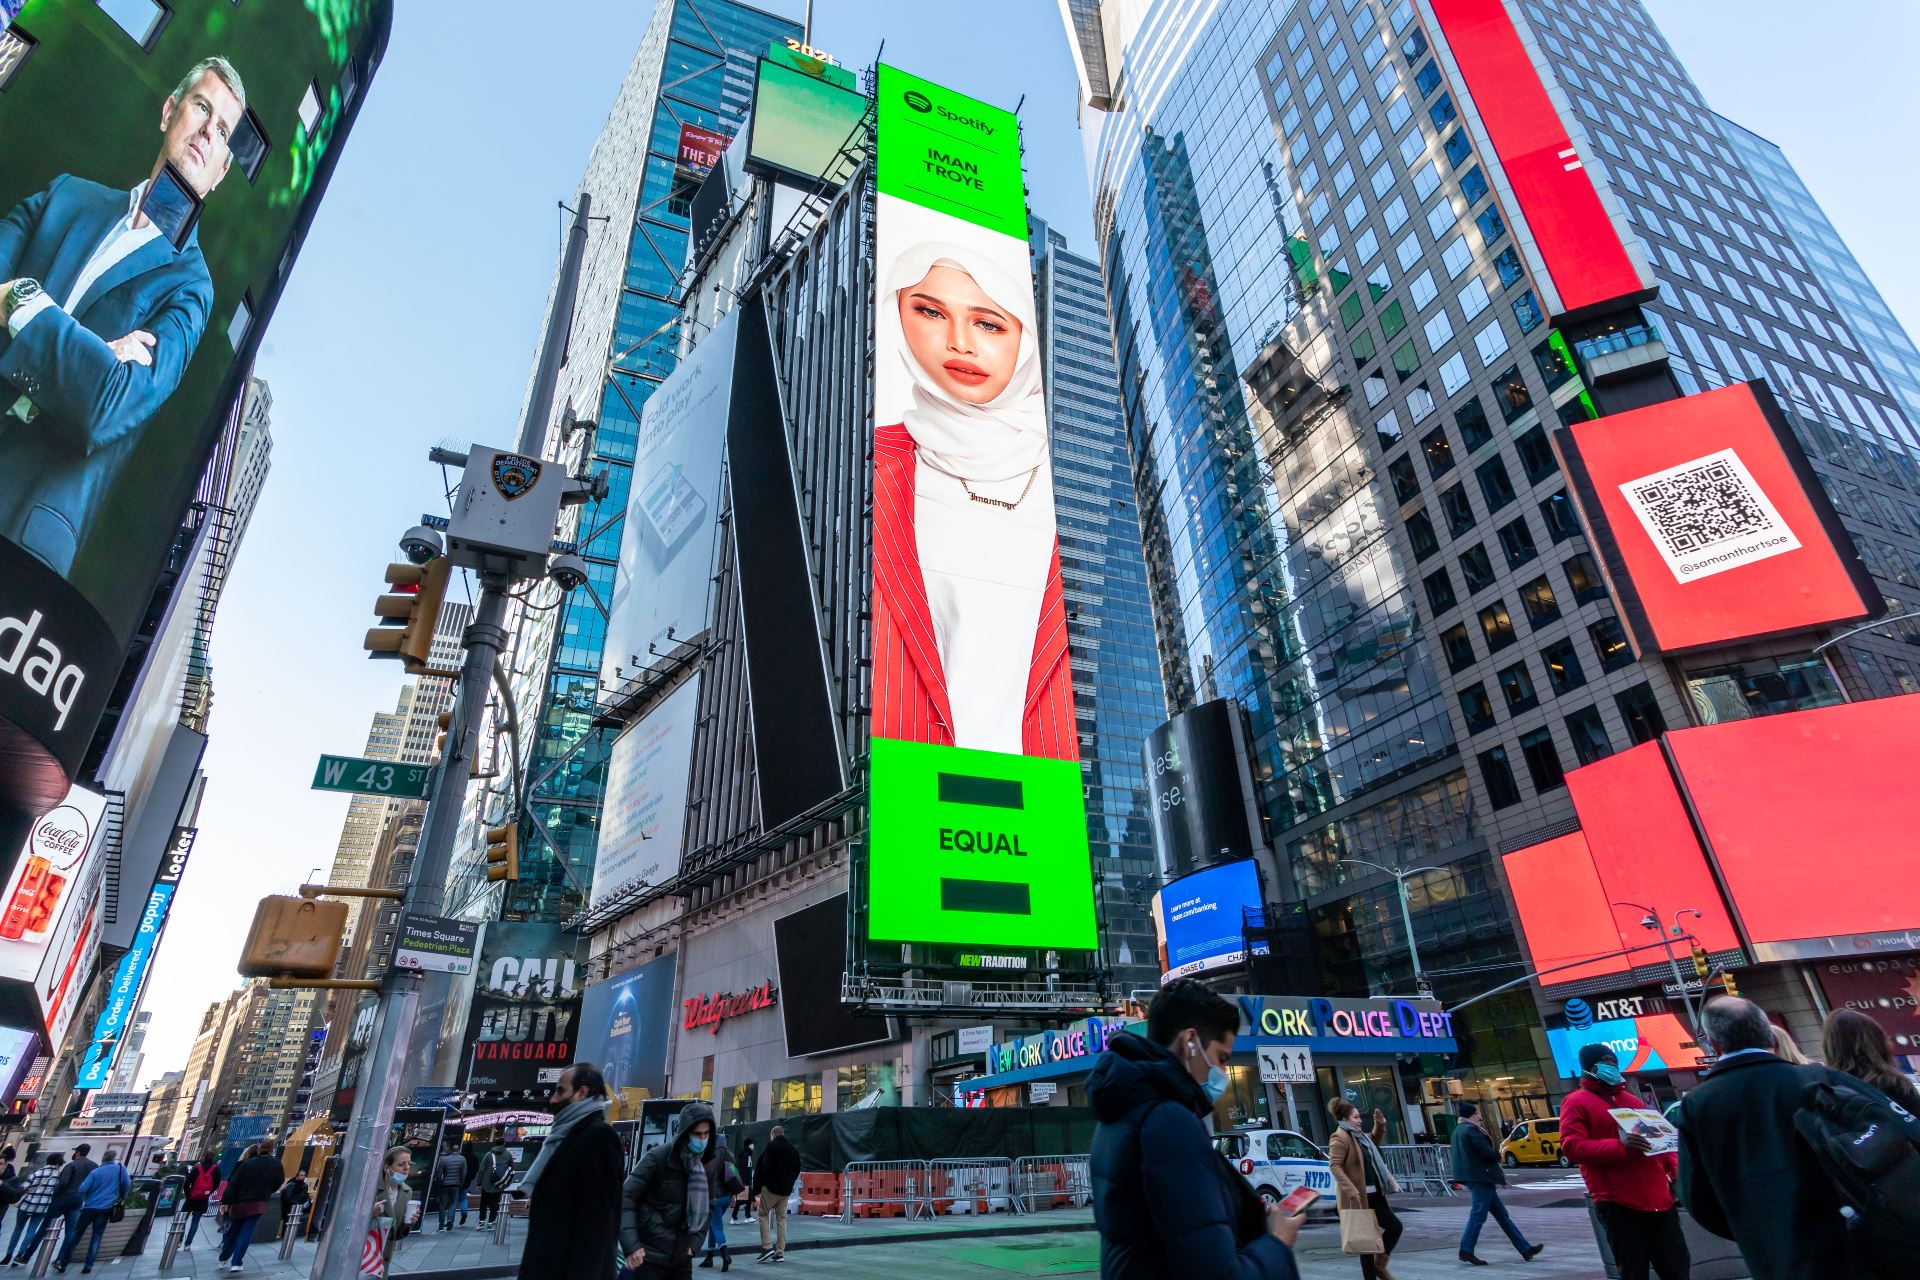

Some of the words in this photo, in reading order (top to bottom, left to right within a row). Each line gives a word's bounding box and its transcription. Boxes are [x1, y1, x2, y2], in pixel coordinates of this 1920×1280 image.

[937, 105, 994, 136] Spotify
[922, 160, 984, 191] TROYE
[927, 148, 978, 175] IMAN
[552, 540, 578, 551] NYPD
[1680, 536, 1788, 575] @samanthartsoe
[323, 759, 348, 785] W
[356, 764, 395, 791] 43
[407, 769, 425, 783] ST
[44, 840, 74, 855] COFFEE
[939, 827, 1028, 857] EQUAL
[140, 891, 166, 933] gopuff
[1170, 903, 1182, 913] Learn
[1182, 900, 1195, 909] more
[1171, 902, 1217, 922] chase.com/banking
[403, 937, 448, 952] Pedestrian
[448, 944, 471, 955] Plaza
[406, 926, 432, 939] Times
[433, 930, 465, 943] Square
[118, 948, 143, 993] Delivered.
[490, 957, 576, 998] CALL
[1180, 964, 1199, 975] CHASE
[106, 996, 125, 1026] Order.
[482, 1017, 493, 1027] OF
[684, 981, 772, 1034] Walgreens
[1239, 996, 1312, 1036] YORK
[1310, 997, 1393, 1037] POLICE
[1394, 999, 1453, 1037] DEPT
[1597, 996, 1644, 1020] AT&T
[480, 1006, 573, 1041] DUTY
[476, 1043, 568, 1059] VANGUARD
[990, 1044, 1013, 1074] NEW
[1013, 1034, 1042, 1069] YORK
[1043, 1030, 1085, 1062] POLICE
[1304, 1171, 1331, 1189] NYPD
